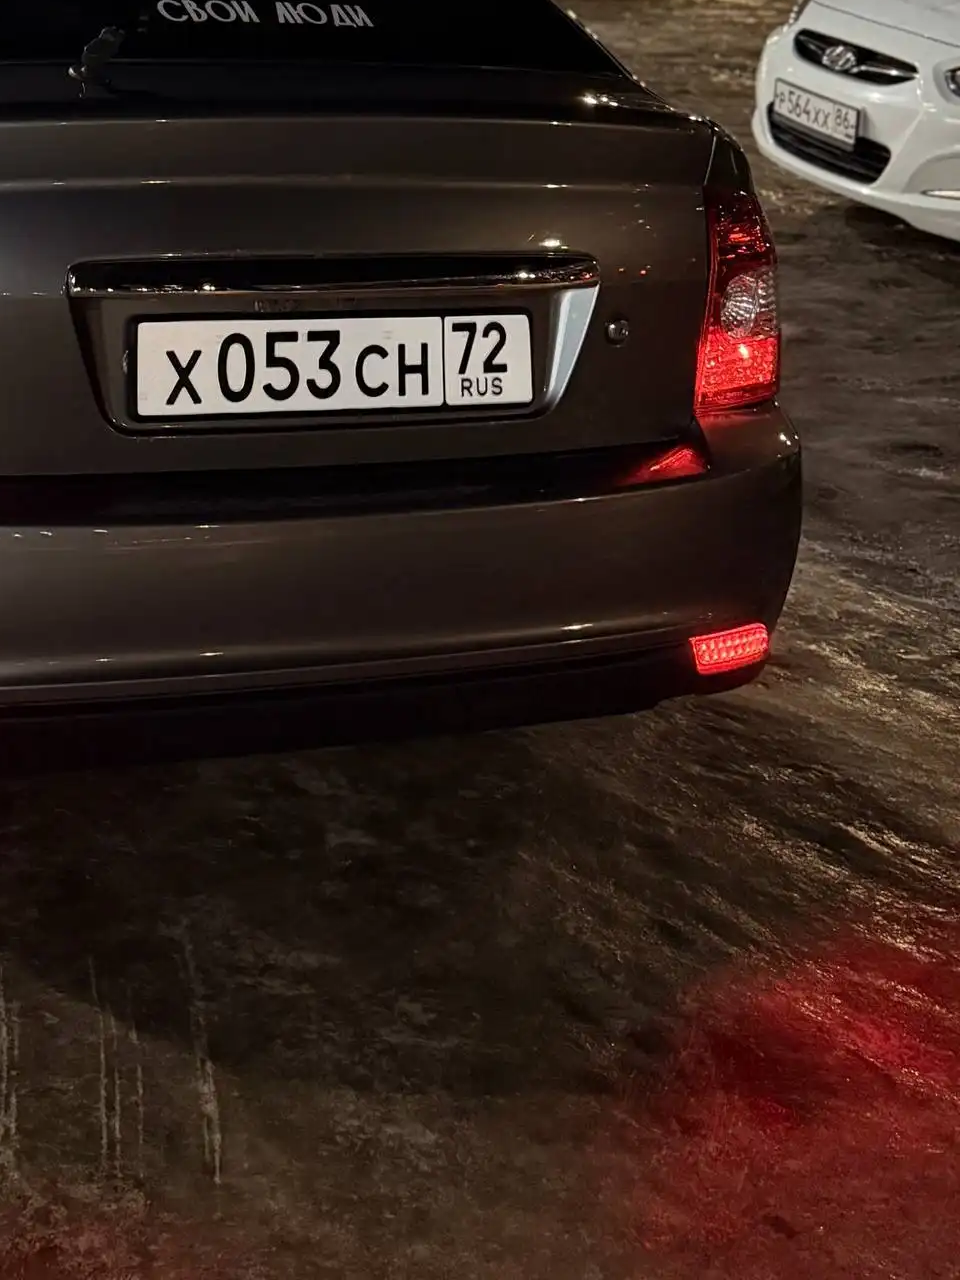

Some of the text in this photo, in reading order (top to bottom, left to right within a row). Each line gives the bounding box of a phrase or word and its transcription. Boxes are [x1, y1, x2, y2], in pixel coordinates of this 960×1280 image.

[157, 0, 374, 28] СВОИ ЛЮДИ
[451, 321, 508, 375] 72
[460, 377, 503, 397] RUS
